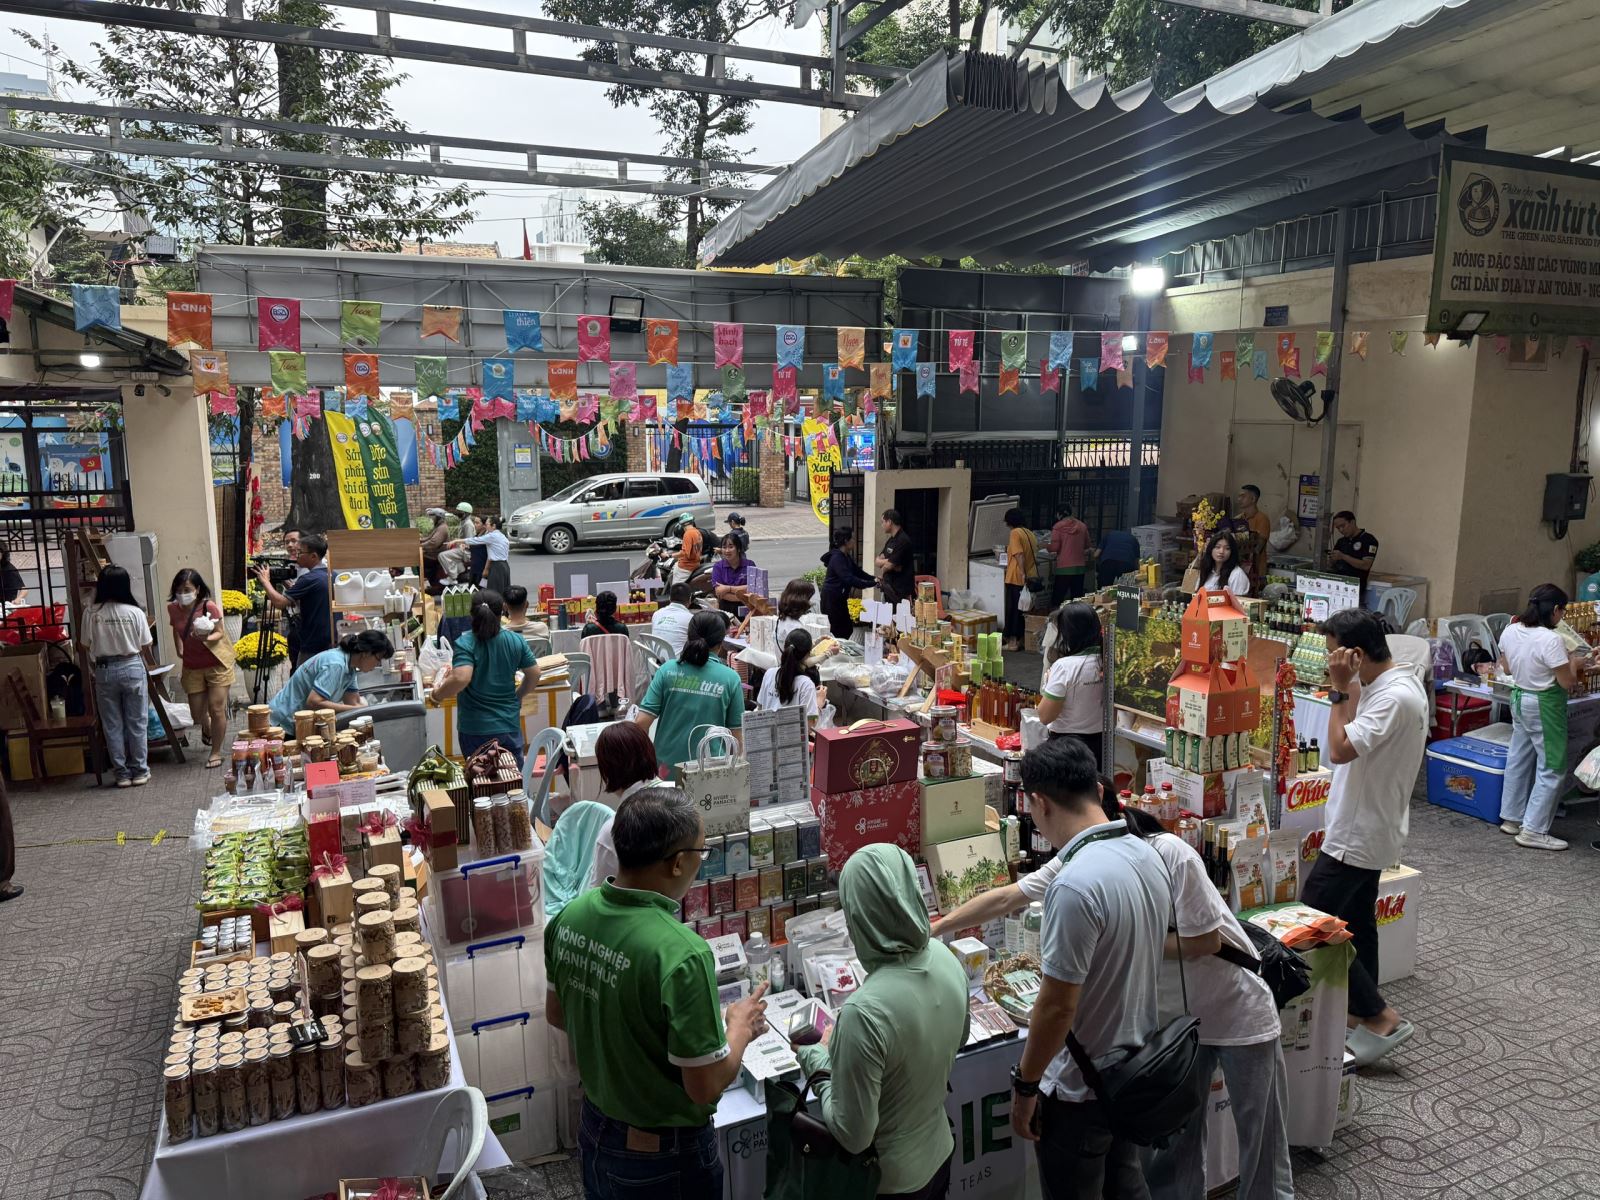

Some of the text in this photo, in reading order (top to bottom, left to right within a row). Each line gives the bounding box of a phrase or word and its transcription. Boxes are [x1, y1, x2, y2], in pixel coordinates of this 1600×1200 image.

[1501, 231, 1516, 240] THE
[1517, 232, 1540, 242] GREEN
[1537, 280, 1553, 295] AN
[557, 925, 631, 971] NÔNG NGHIỆP
[589, 960, 618, 989] PHÚC
[960, 1166, 992, 1191] TEAS
